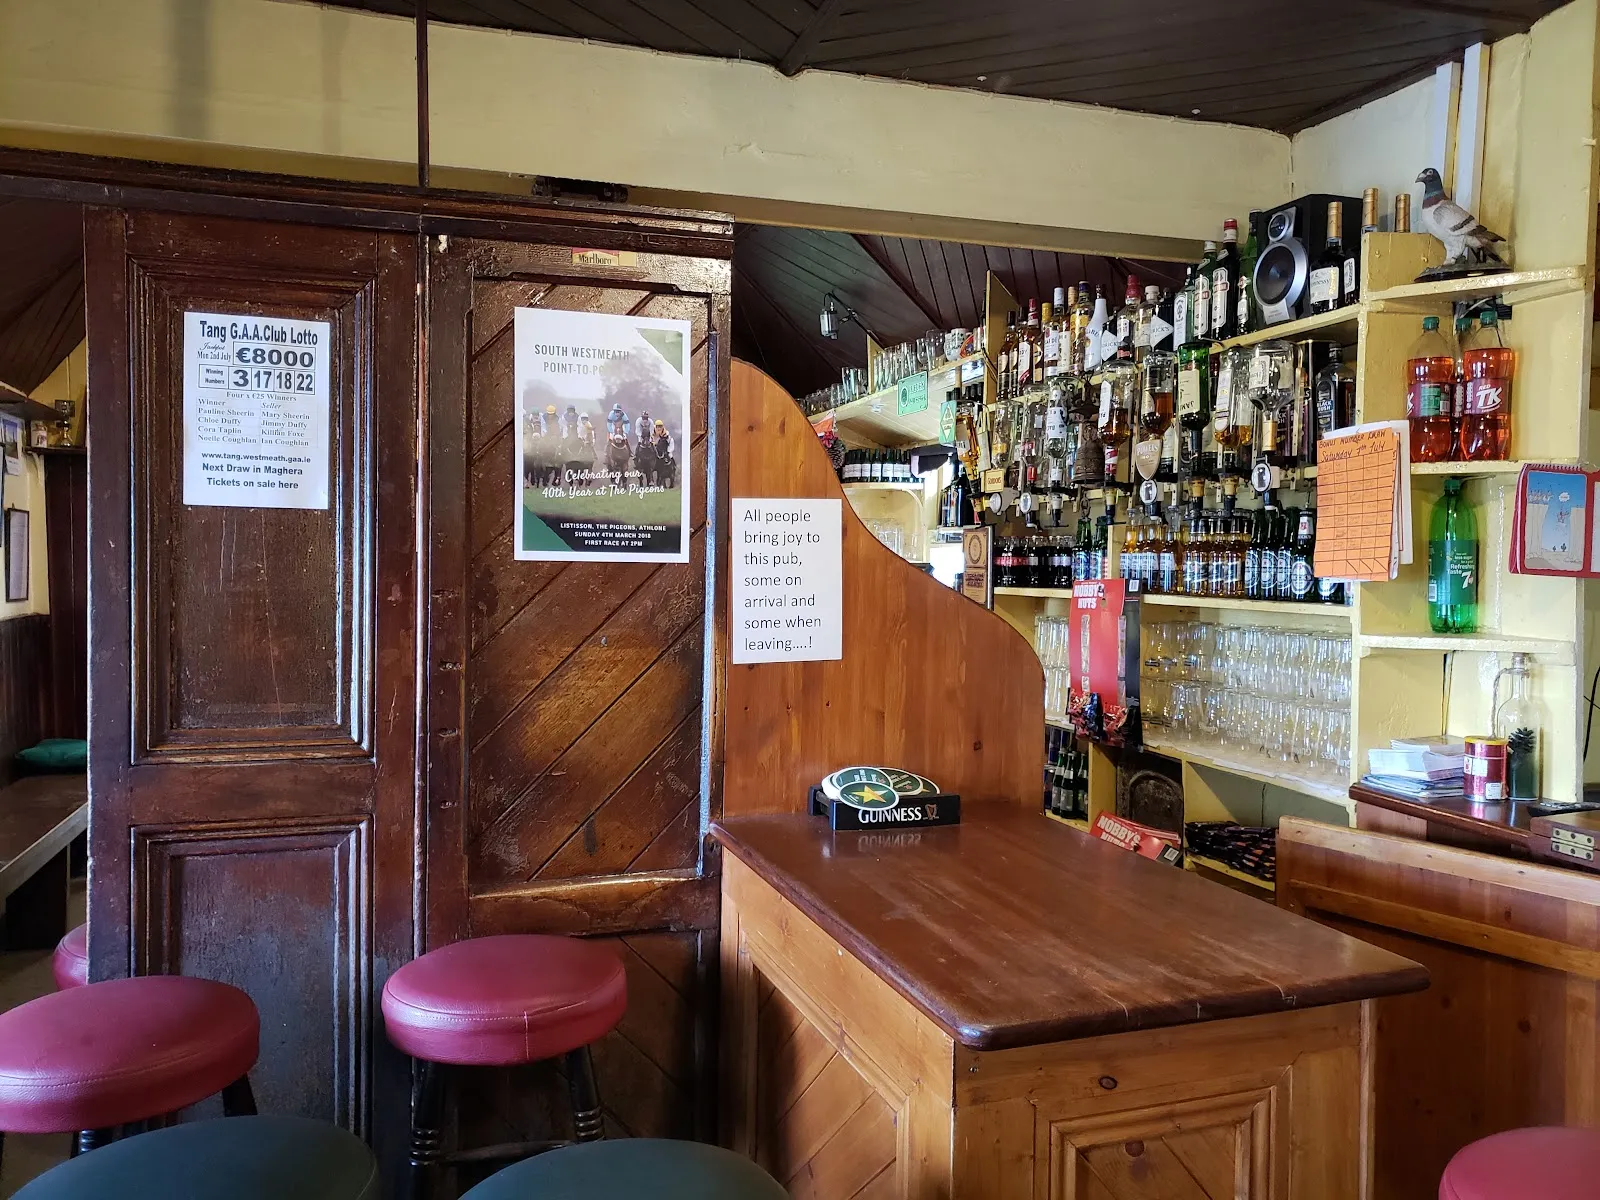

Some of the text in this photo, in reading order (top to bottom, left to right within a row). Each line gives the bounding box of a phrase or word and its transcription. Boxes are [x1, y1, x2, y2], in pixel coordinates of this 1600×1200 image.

[579, 253, 612, 265] Marlboro
[200, 320, 318, 345] Tang G.A.A.Club Lotto
[210, 351, 220, 360] 2nd
[221, 352, 232, 362] July
[236, 347, 314, 368] €8000
[534, 344, 630, 360] SOUTH WESTMEATH
[233, 369, 313, 392] 3 17 18 22
[266, 394, 297, 402] Winners
[1476, 386, 1502, 408] TK
[228, 408, 254, 416] Sheerin
[262, 412, 281, 420] Mary
[222, 418, 242, 426] Duffy
[261, 420, 308, 429] Jimmy Duffy
[218, 426, 242, 435] Taplin
[222, 436, 256, 444] Coughlan
[275, 438, 309, 446] Coughlan
[1319, 440, 1336, 448] BONUS
[1340, 434, 1364, 444] NUMBER
[202, 452, 311, 463] www.tang.westmeath.gaa.ie
[1321, 450, 1352, 462] Saturday
[202, 463, 303, 476] Next Draw in Maghera
[565, 468, 642, 484] Celebrating our
[207, 478, 240, 486] Tickets
[257, 480, 276, 488] sale
[278, 480, 298, 489] here
[542, 484, 665, 500] 40th Year at The Pigeons
[744, 508, 812, 524] All people
[744, 530, 820, 546] bring joy to
[744, 552, 802, 568] this pub,
[744, 575, 802, 587] some on
[744, 594, 815, 608] arrival and
[1078, 598, 1097, 608] NUTS
[744, 616, 821, 629] some when
[745, 636, 812, 652] leaving....!
[858, 807, 922, 824] GUINNESS
[1097, 816, 1140, 846] NOBBY'S
